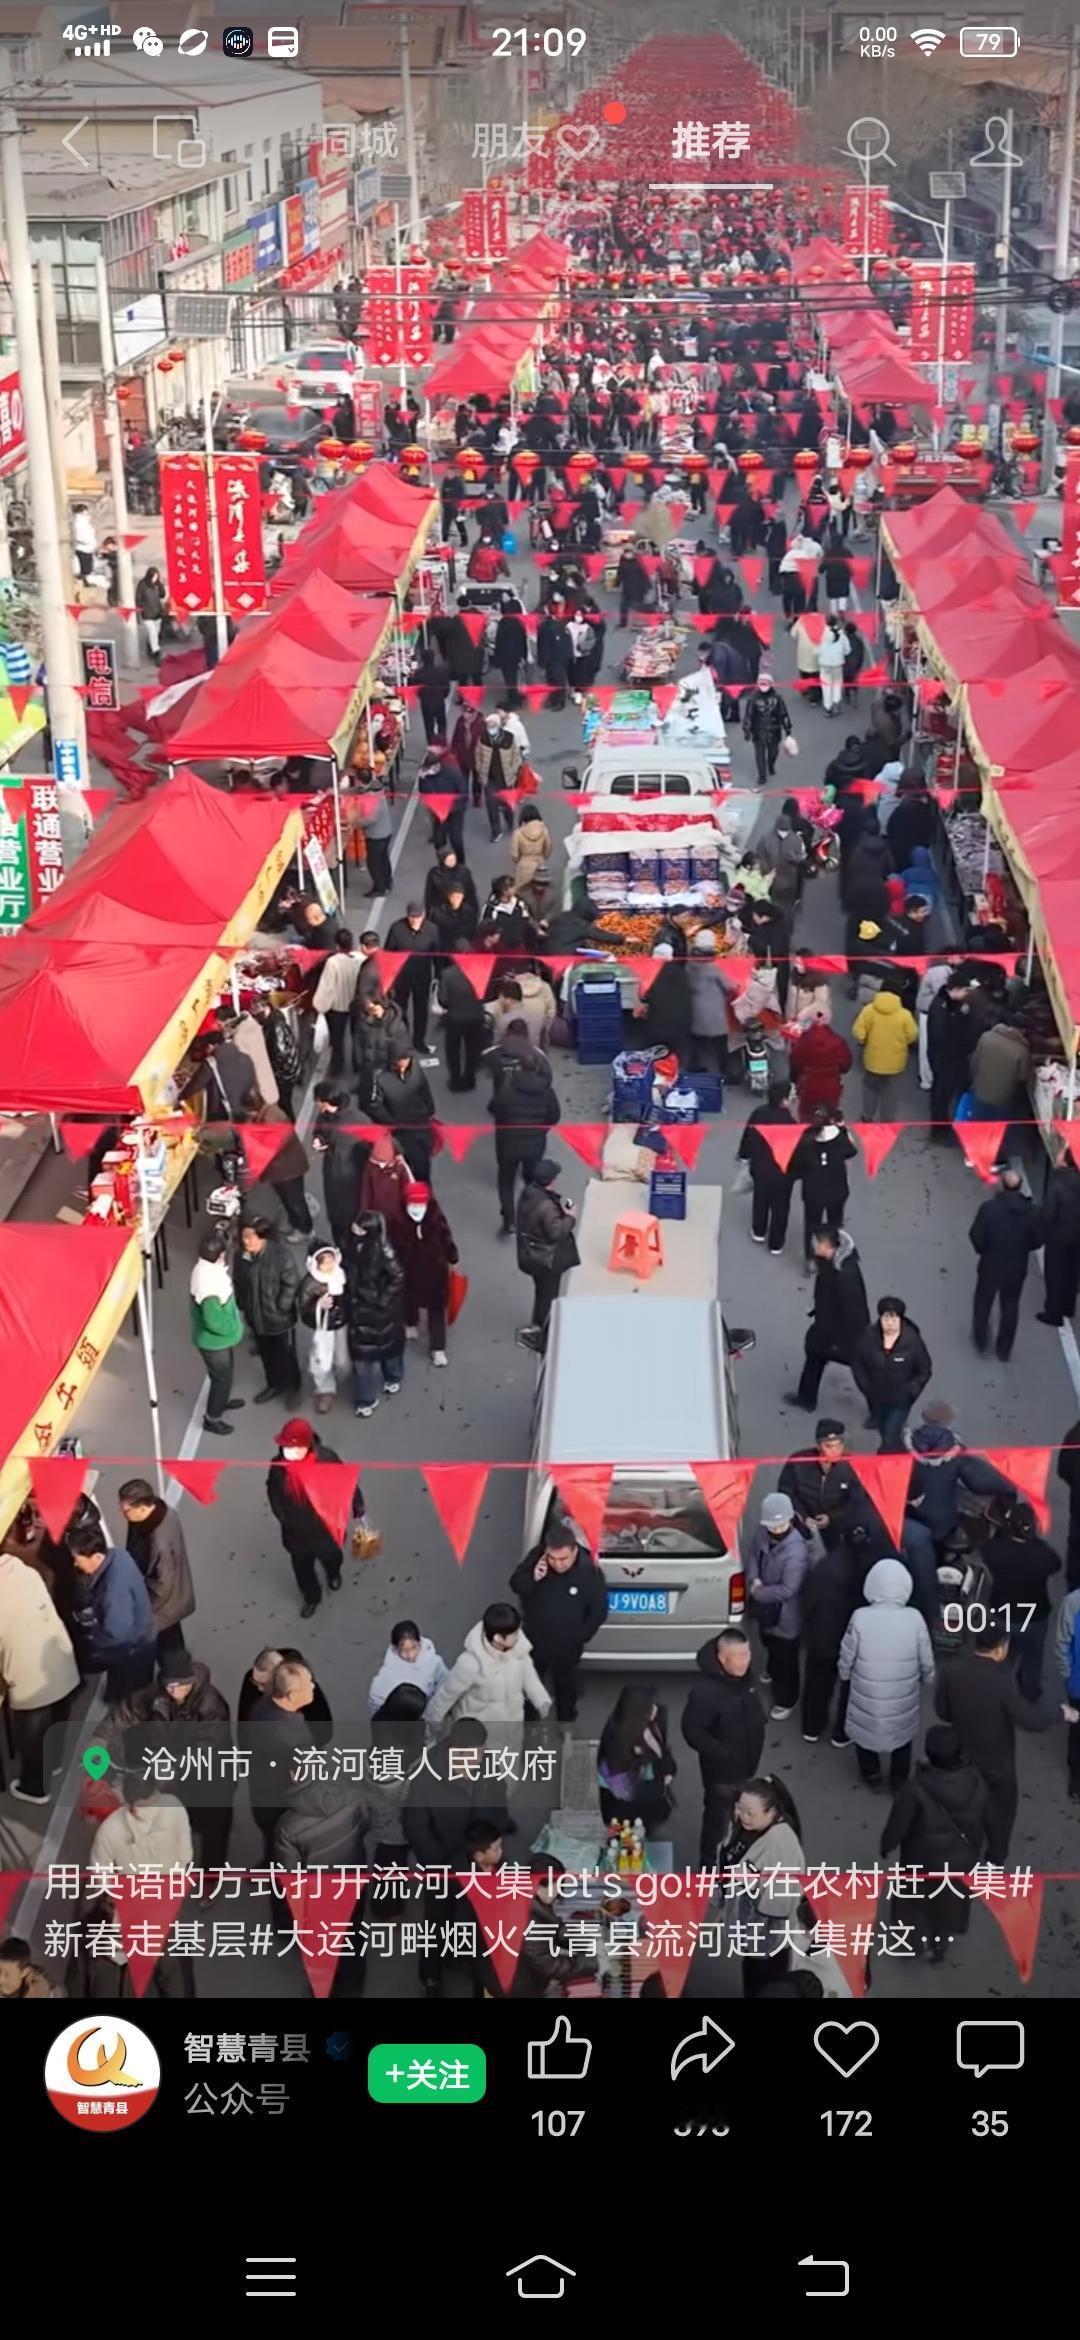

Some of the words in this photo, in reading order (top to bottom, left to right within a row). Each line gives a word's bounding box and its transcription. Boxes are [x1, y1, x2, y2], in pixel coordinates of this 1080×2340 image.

[86, 646, 113, 706] 电信
[30, 785, 66, 904] 联通营业
